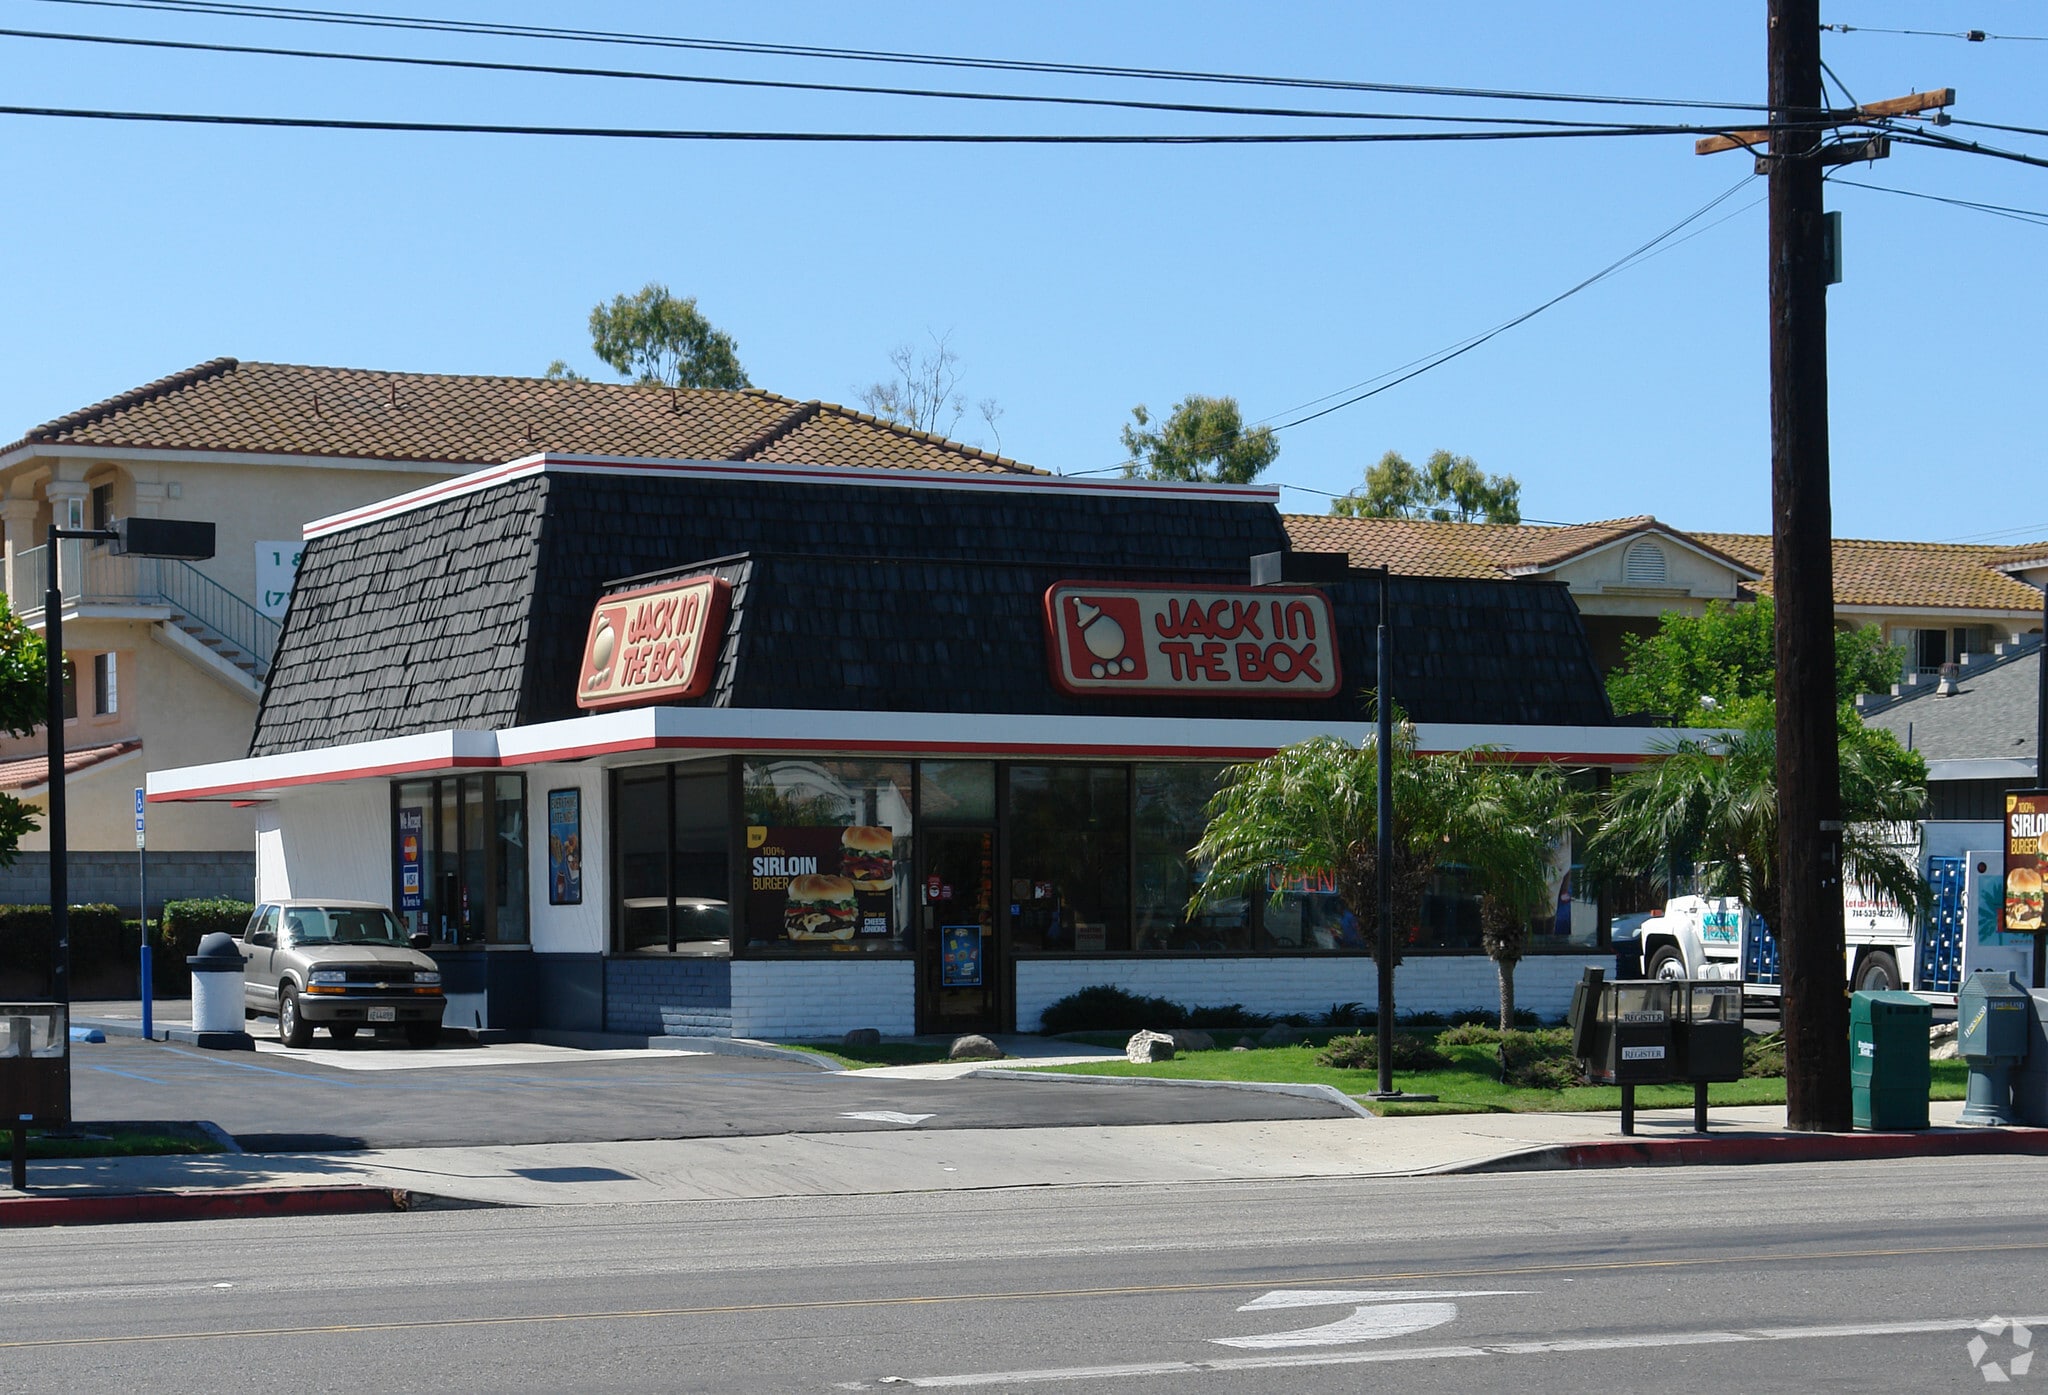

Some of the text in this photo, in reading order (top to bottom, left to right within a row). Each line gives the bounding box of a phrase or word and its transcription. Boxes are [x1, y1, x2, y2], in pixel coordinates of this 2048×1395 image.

[273, 552, 281, 566] 1
[265, 590, 290, 608] (7
[627, 592, 700, 645] JACK IN
[1155, 598, 1317, 641] JACK IN
[620, 636, 691, 688] THE BOX
[1158, 642, 1323, 683] THE BOX
[762, 847, 785, 856] 100%
[2010, 838, 2039, 855] BURGER
[752, 856, 817, 876] SIRLOIN
[753, 877, 789, 890] BURGER
[1270, 864, 1334, 892] OPEN
[864, 917, 887, 926] CHEESE
[1624, 1013, 1663, 1022] REGISTER
[1624, 1050, 1662, 1058] REGISTER
